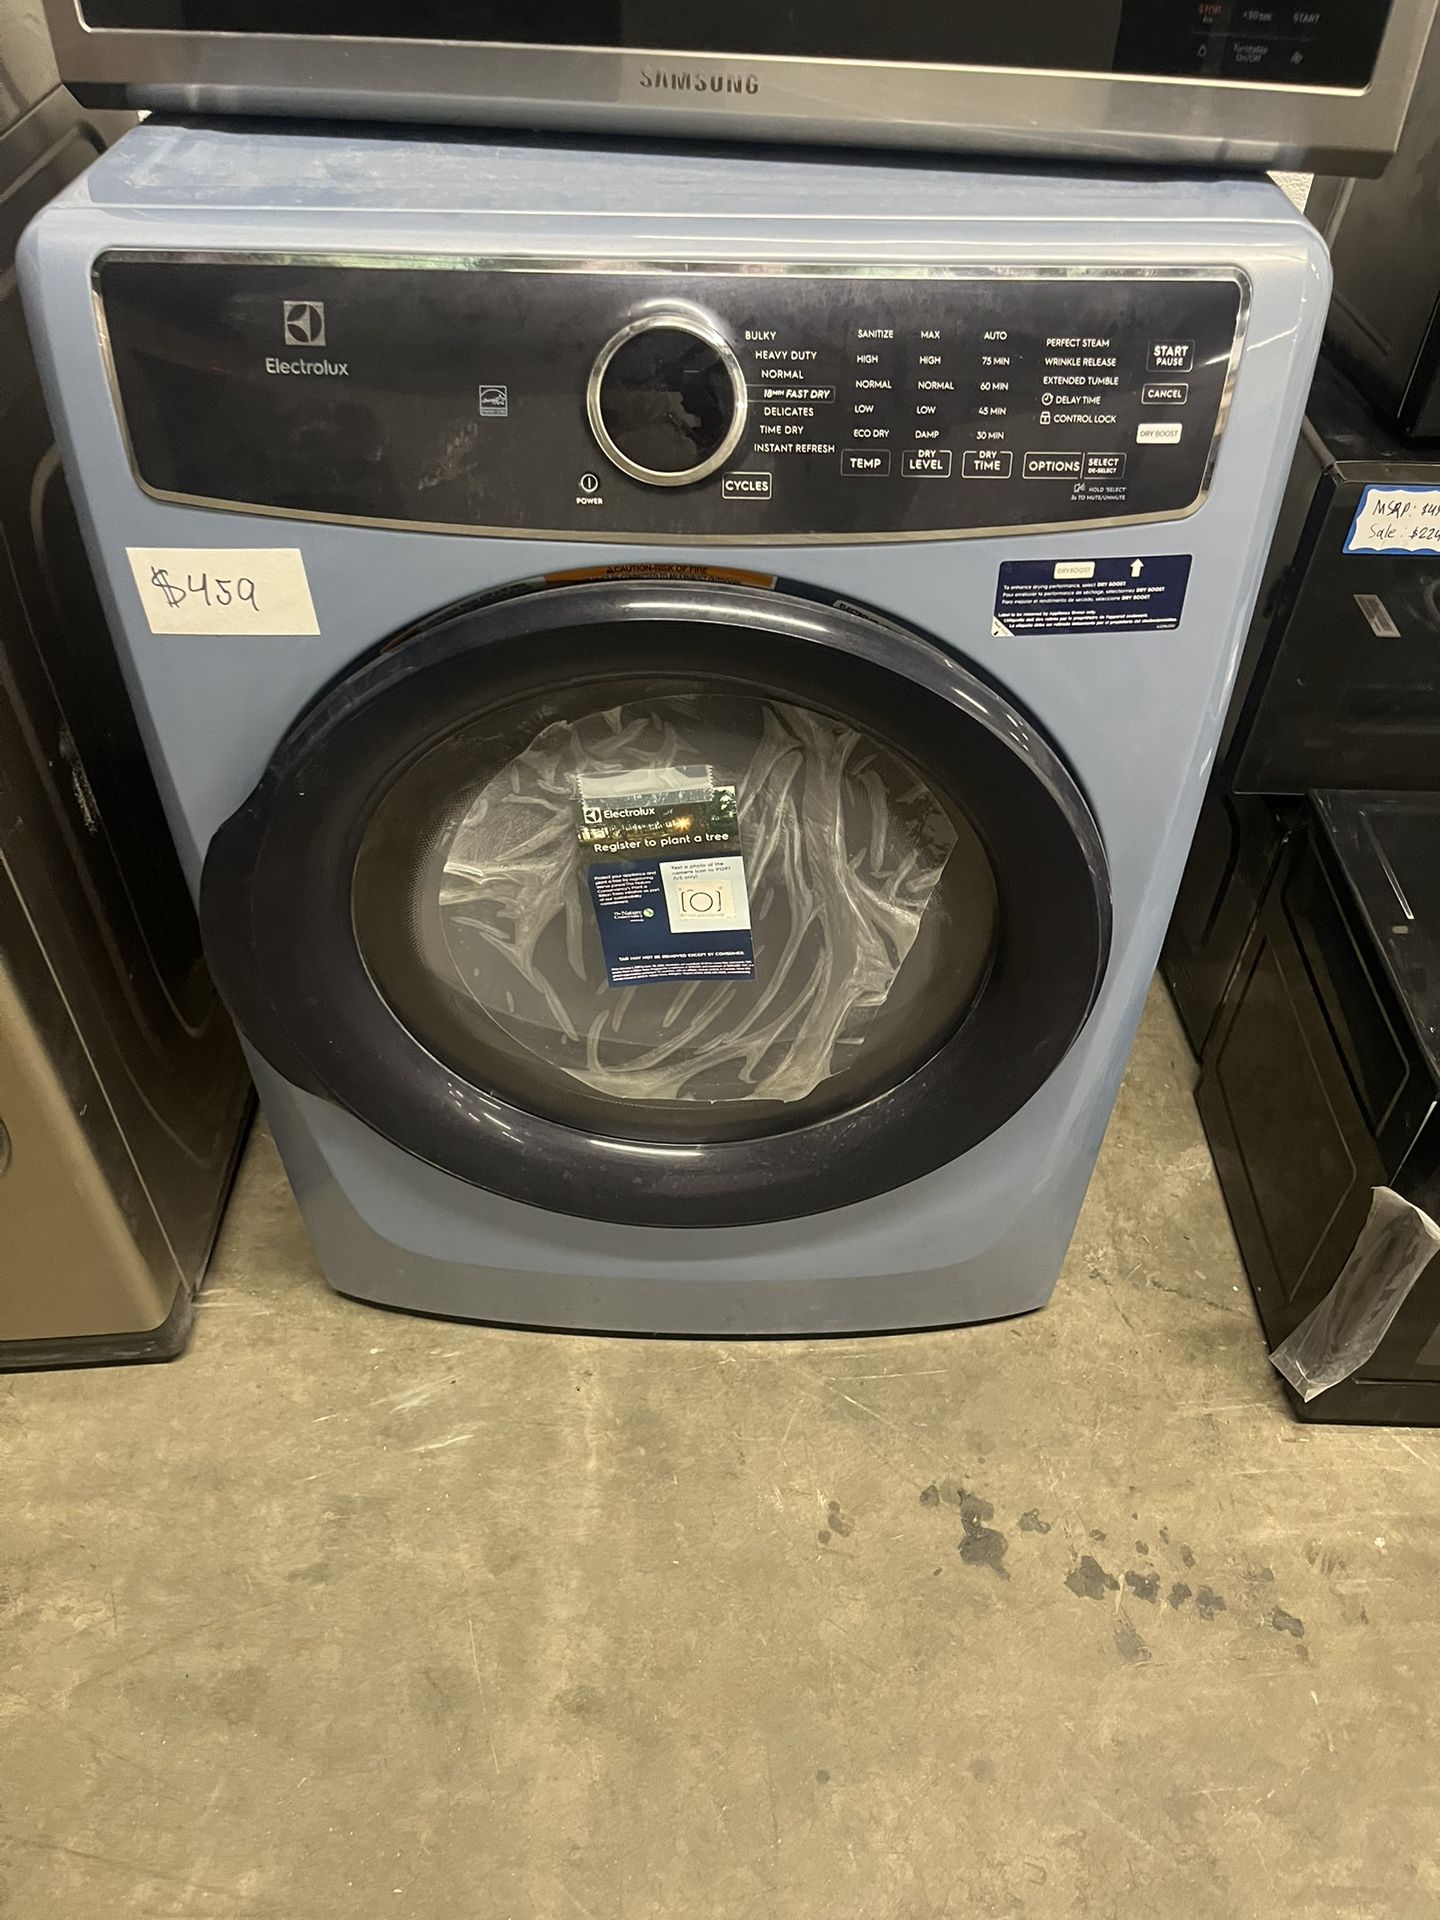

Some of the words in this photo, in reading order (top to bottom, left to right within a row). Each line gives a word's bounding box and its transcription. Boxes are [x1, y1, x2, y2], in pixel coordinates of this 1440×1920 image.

[1293, 12, 1320, 24] START
[640, 69, 759, 94] SAMSUNG
[744, 330, 776, 340] BULKY
[857, 329, 894, 339] SANITIZE
[920, 330, 940, 340] MAX
[984, 331, 1008, 340] AUTO
[1046, 338, 1081, 348] PERFECT
[1082, 338, 1110, 348] STEAM
[756, 350, 788, 360] HEAVY
[790, 350, 818, 360] DUTY
[1154, 346, 1189, 357] START
[856, 354, 878, 364] HIGH
[919, 356, 942, 365] HIGH
[982, 356, 992, 366] 75
[993, 356, 1010, 366] MIN
[1044, 358, 1081, 367] WRINKLE
[1082, 358, 1117, 368] RELEASE
[1156, 357, 1184, 366] PAUSE
[265, 357, 349, 376] Electrolux
[761, 369, 804, 380] NORMAL
[856, 380, 892, 390] NORMAL
[918, 381, 954, 390] NORMAL
[1043, 376, 1086, 386] EXTENDED
[1086, 377, 1119, 386] TUMBLE
[980, 382, 991, 391] 60
[992, 382, 1008, 391] MIN
[786, 389, 809, 399] FAST
[810, 390, 831, 400] DRY
[1148, 390, 1182, 399] CANCEL
[1056, 396, 1081, 405] DELAY
[1082, 396, 1101, 404] TIME
[764, 406, 814, 417] DELICATES
[854, 404, 874, 414] LOW
[916, 406, 936, 415] LOW
[978, 406, 989, 416] 45
[990, 406, 1007, 416] MIN
[1054, 414, 1094, 424] CONTROL
[1094, 414, 1116, 424] LOCK
[760, 424, 782, 434] TIME
[784, 425, 804, 435] DRY
[854, 428, 872, 438] ECO
[873, 428, 890, 438] DRY
[1140, 429, 1154, 438] DRY
[1155, 429, 1179, 438] BOOST
[915, 430, 940, 440] DAMP
[976, 430, 988, 440] 30
[988, 431, 1005, 440] MIN
[754, 442, 793, 453] INSTANT
[795, 443, 836, 454] REFRESH
[918, 450, 936, 458] DRY
[980, 450, 998, 459] DRY
[850, 457, 882, 469] TEMP
[910, 458, 944, 470] LEVEL
[974, 460, 1001, 472] TIME
[1028, 460, 1080, 472] OPTIONS
[1088, 458, 1119, 468] SELECT
[725, 480, 769, 492] CYCLES
[576, 497, 603, 505] POWER
[604, 806, 656, 819] Electrolux
[594, 840, 641, 853] Register
[644, 839, 656, 848] to
[660, 836, 690, 848] plant
[706, 832, 729, 842] tree
